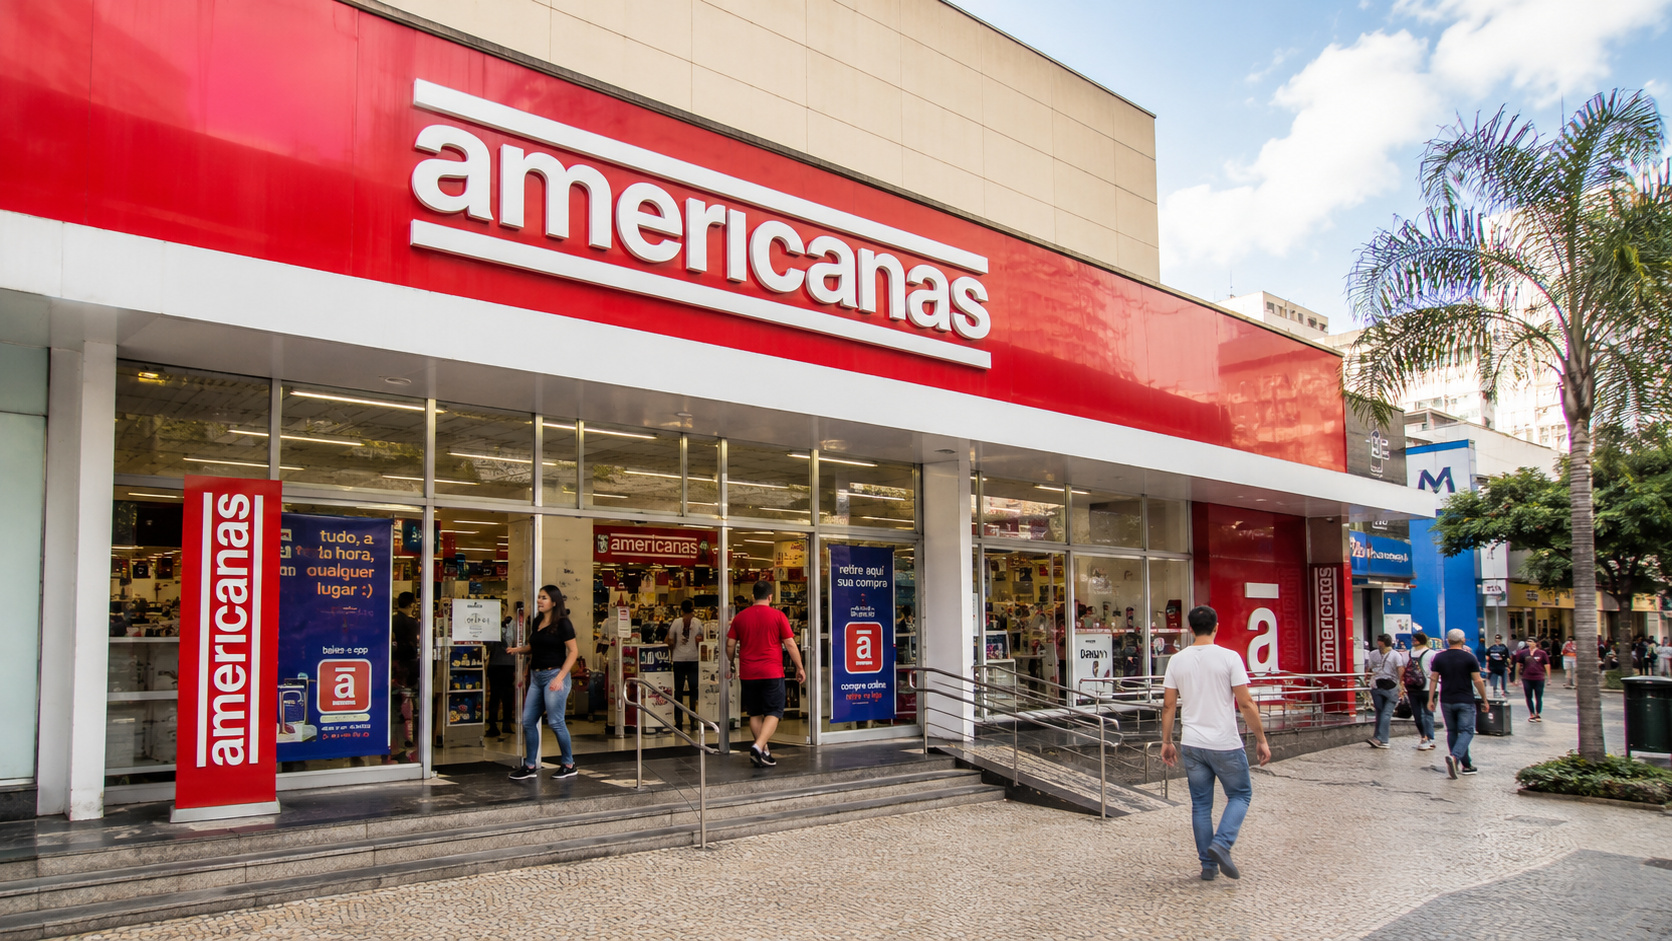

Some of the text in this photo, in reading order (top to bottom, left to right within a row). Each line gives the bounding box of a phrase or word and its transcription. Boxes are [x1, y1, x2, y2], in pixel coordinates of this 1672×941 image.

[411, 124, 991, 340] americanas
[320, 530, 374, 546] tudo, a
[611, 536, 698, 554] americanas
[336, 546, 375, 563] hora,
[317, 582, 357, 598] lugar
[837, 578, 888, 590] sua compra
[211, 493, 250, 766] americanas
[856, 636, 872, 659] a
[1247, 607, 1280, 677] a
[334, 673, 355, 698] a
